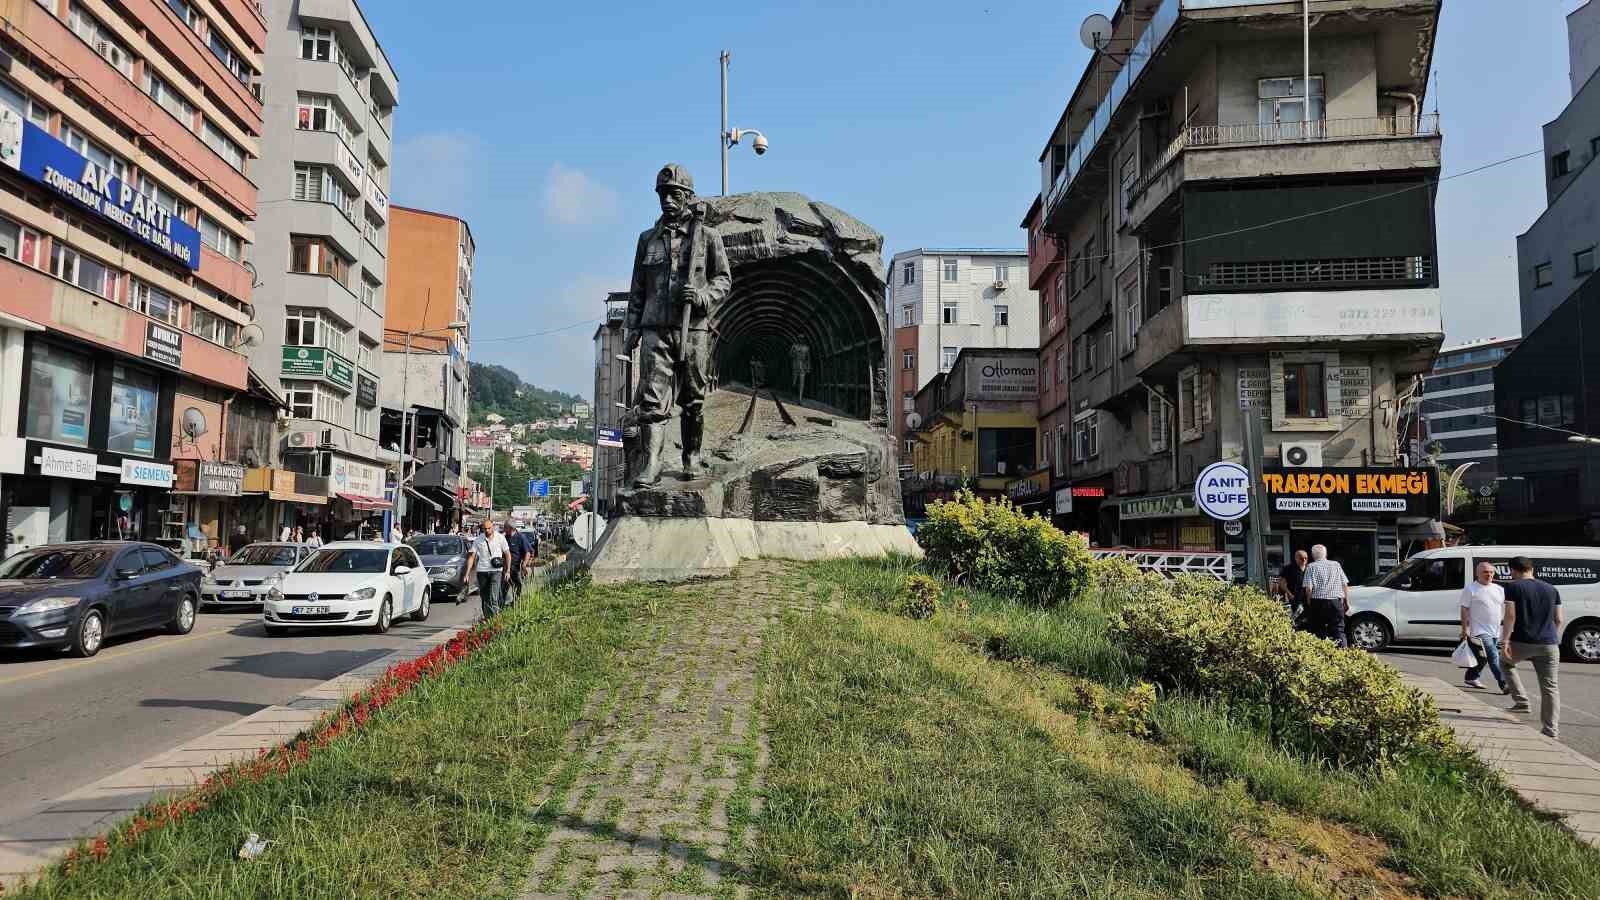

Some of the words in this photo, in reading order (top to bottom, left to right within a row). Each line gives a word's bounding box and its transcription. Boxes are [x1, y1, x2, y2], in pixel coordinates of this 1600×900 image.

[81, 161, 115, 200] AK
[43, 166, 101, 212] ZONGULDAK
[103, 199, 133, 230] MERKEZ
[982, 359, 1036, 378] Ottoman
[45, 456, 74, 472] Ahmet
[1207, 477, 1246, 488] ANIT
[1262, 473, 1350, 494] TRABZON
[1356, 471, 1429, 495] EKMEĞİ
[1206, 491, 1247, 504] BÜFE
